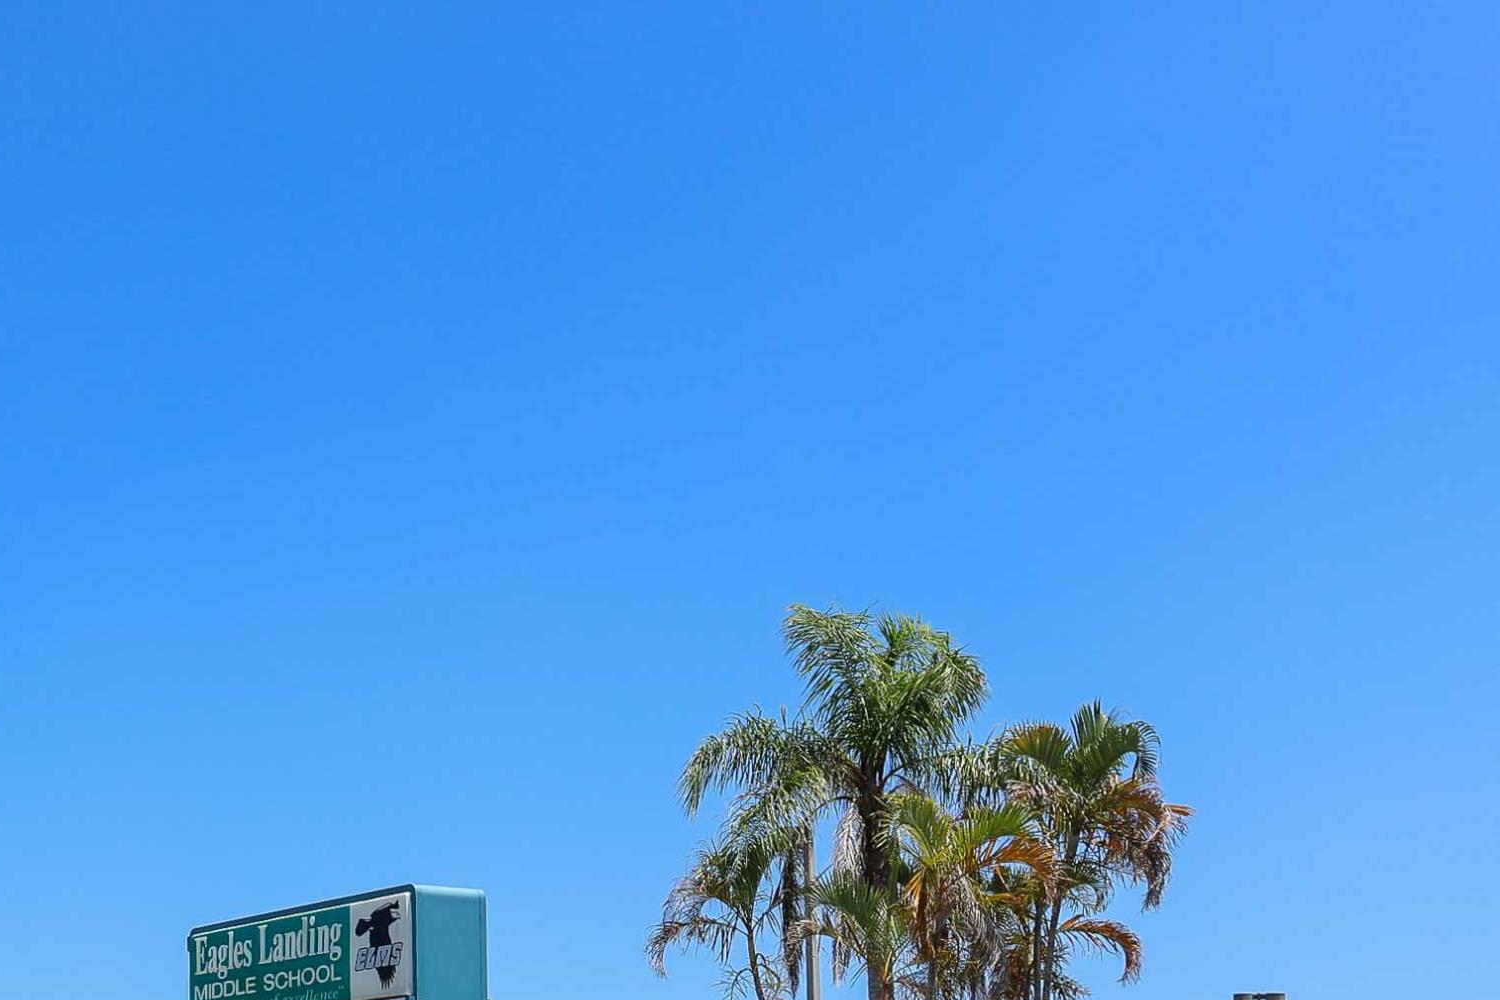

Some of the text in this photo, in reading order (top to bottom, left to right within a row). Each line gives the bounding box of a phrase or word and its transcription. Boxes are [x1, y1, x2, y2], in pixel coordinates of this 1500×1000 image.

[194, 916, 343, 979] Eagles Landing
[355, 942, 403, 971] ELMS
[194, 964, 342, 1000] MIDDLE SCHOOL
